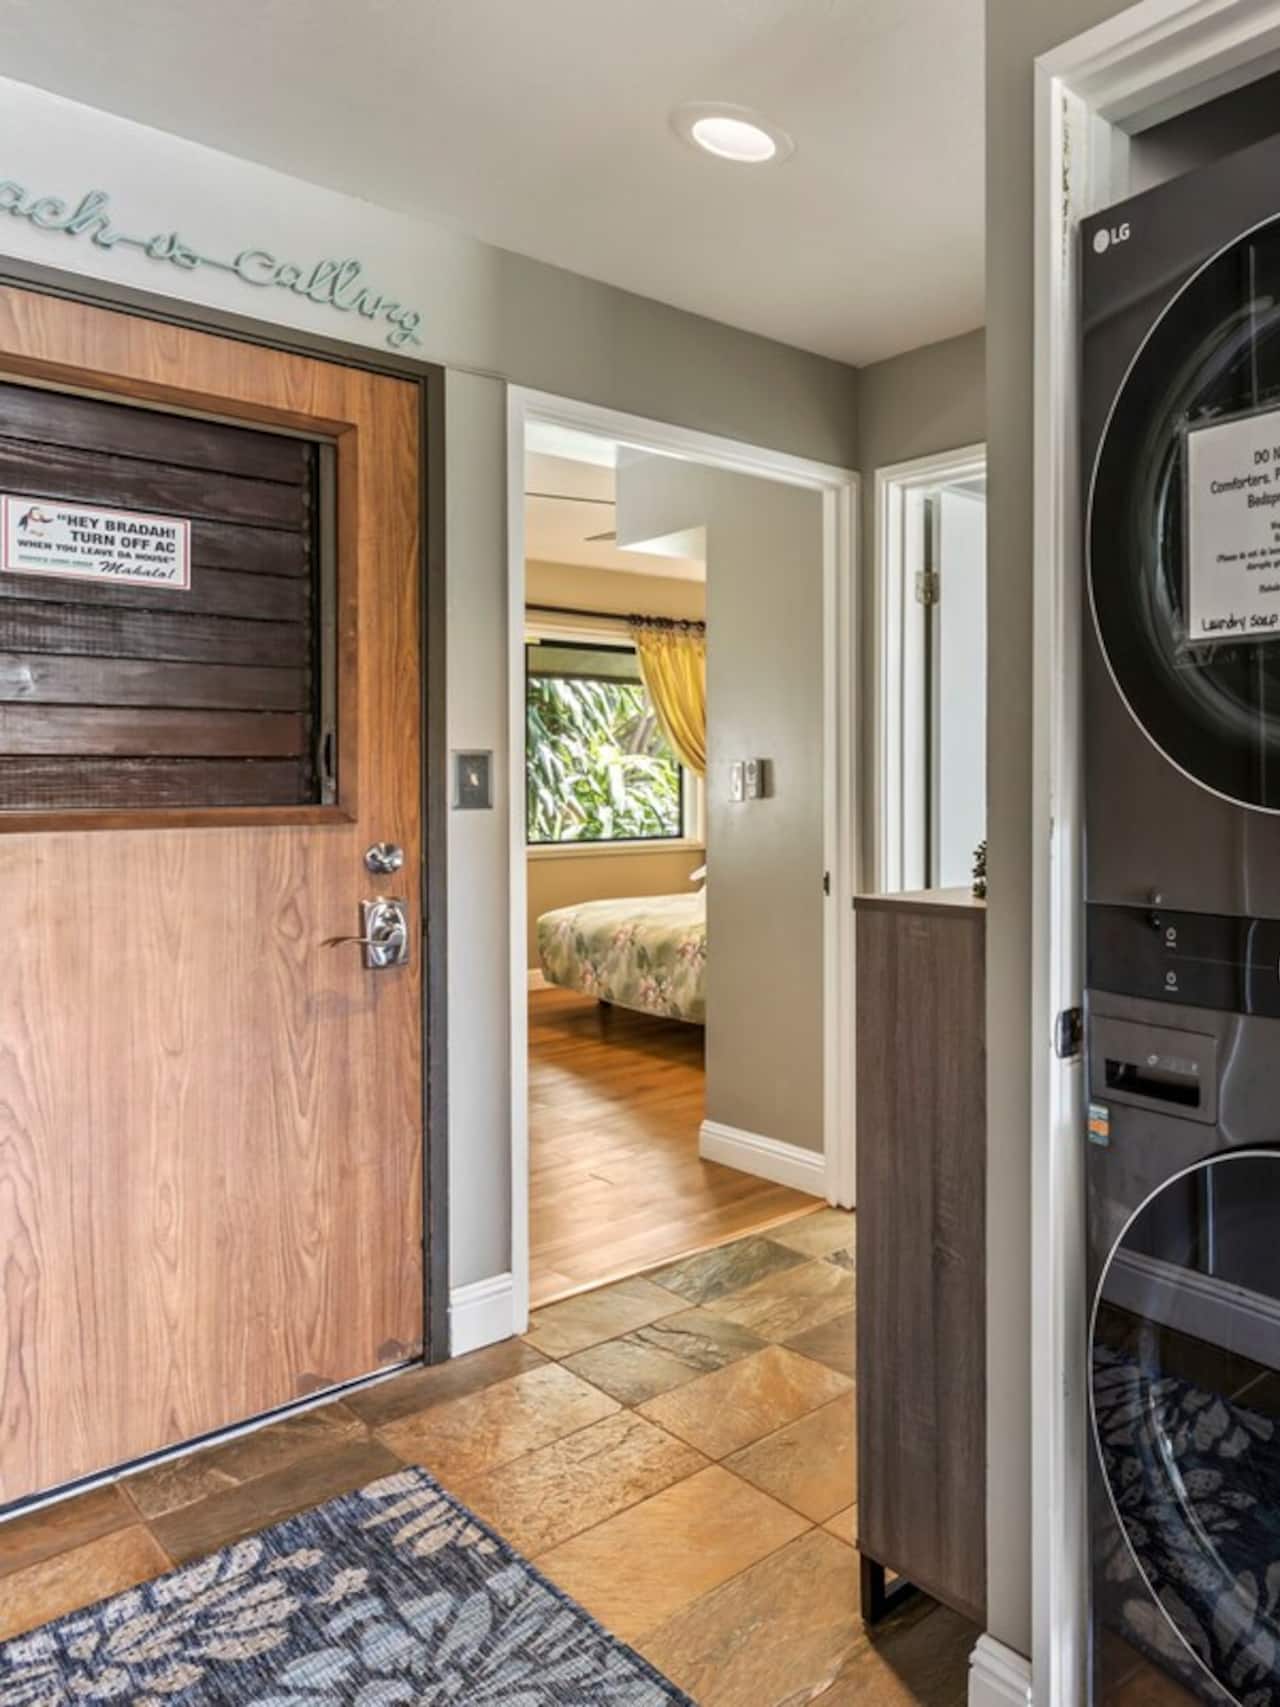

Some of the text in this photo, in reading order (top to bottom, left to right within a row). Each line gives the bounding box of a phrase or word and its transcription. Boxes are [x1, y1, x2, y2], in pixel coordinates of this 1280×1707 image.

[1111, 222, 1130, 245] LG
[1254, 449, 1270, 464] DO
[104, 519, 176, 539] BRADAH!
[17, 539, 52, 550] WHEN
[55, 543, 77, 553] YOU
[80, 546, 114, 558] LEAVE
[117, 550, 133, 560] DA
[69, 530, 175, 553] TURN OFF AC
[100, 561, 175, 579] Mahalo!
